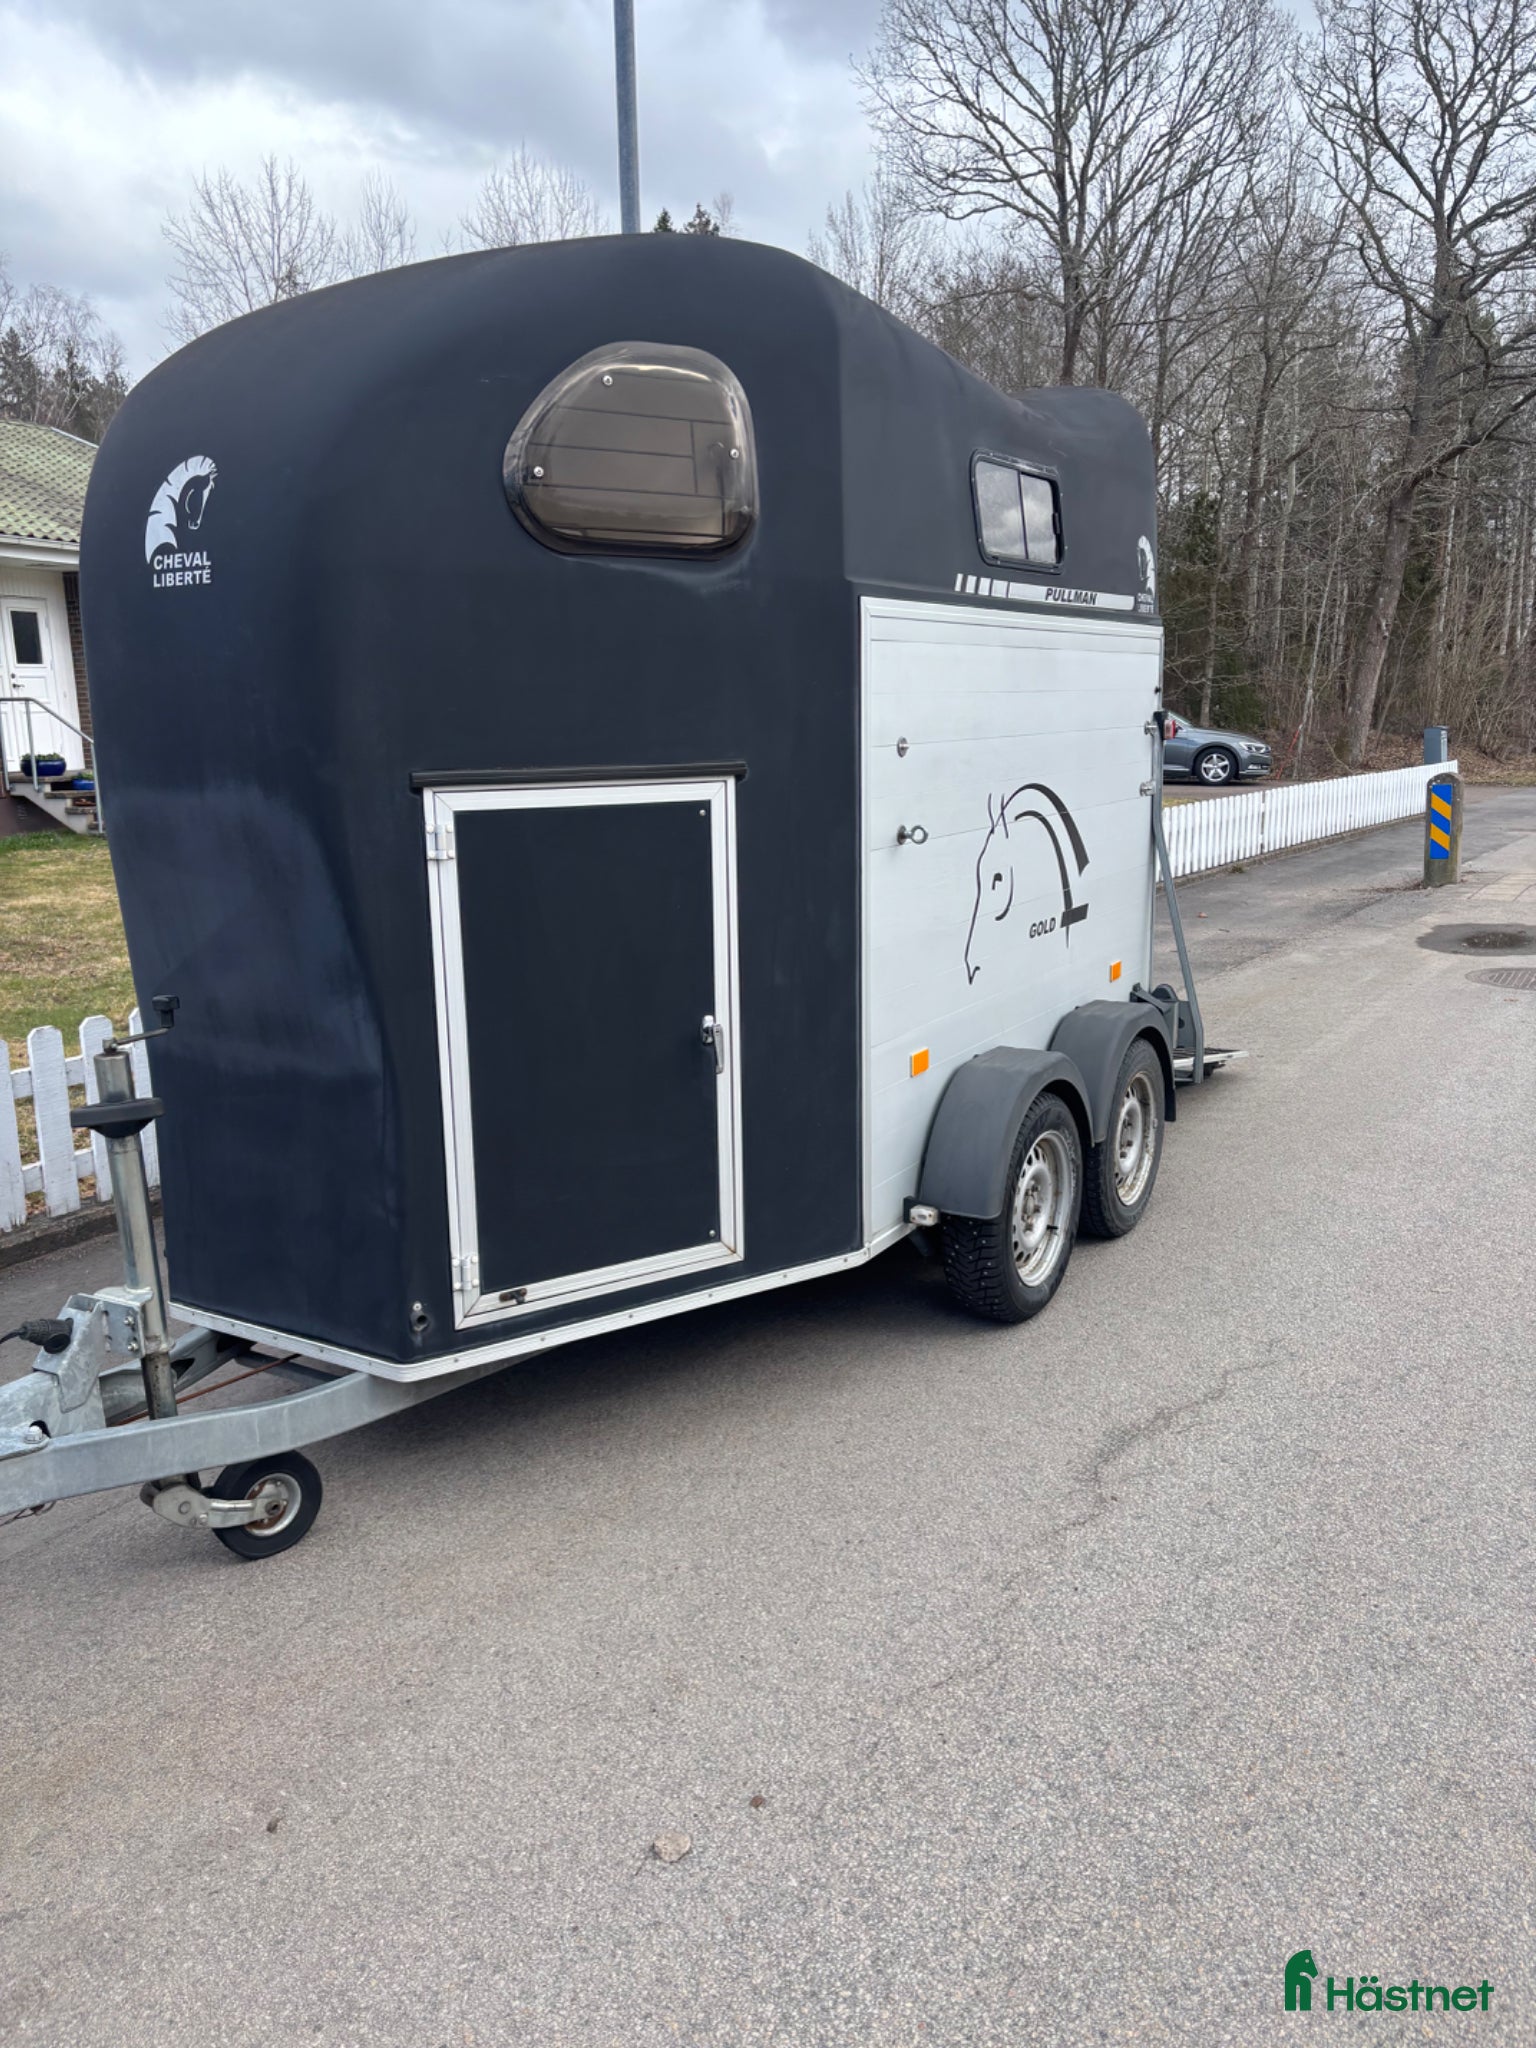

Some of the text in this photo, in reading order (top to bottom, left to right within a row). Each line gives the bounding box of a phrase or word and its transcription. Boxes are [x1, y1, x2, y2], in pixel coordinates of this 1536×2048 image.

[153, 551, 212, 570] CHEVAL
[153, 566, 212, 588] LIBERTÉ
[1045, 587, 1097, 606] PULLMAN
[1029, 917, 1056, 938] GOLD
